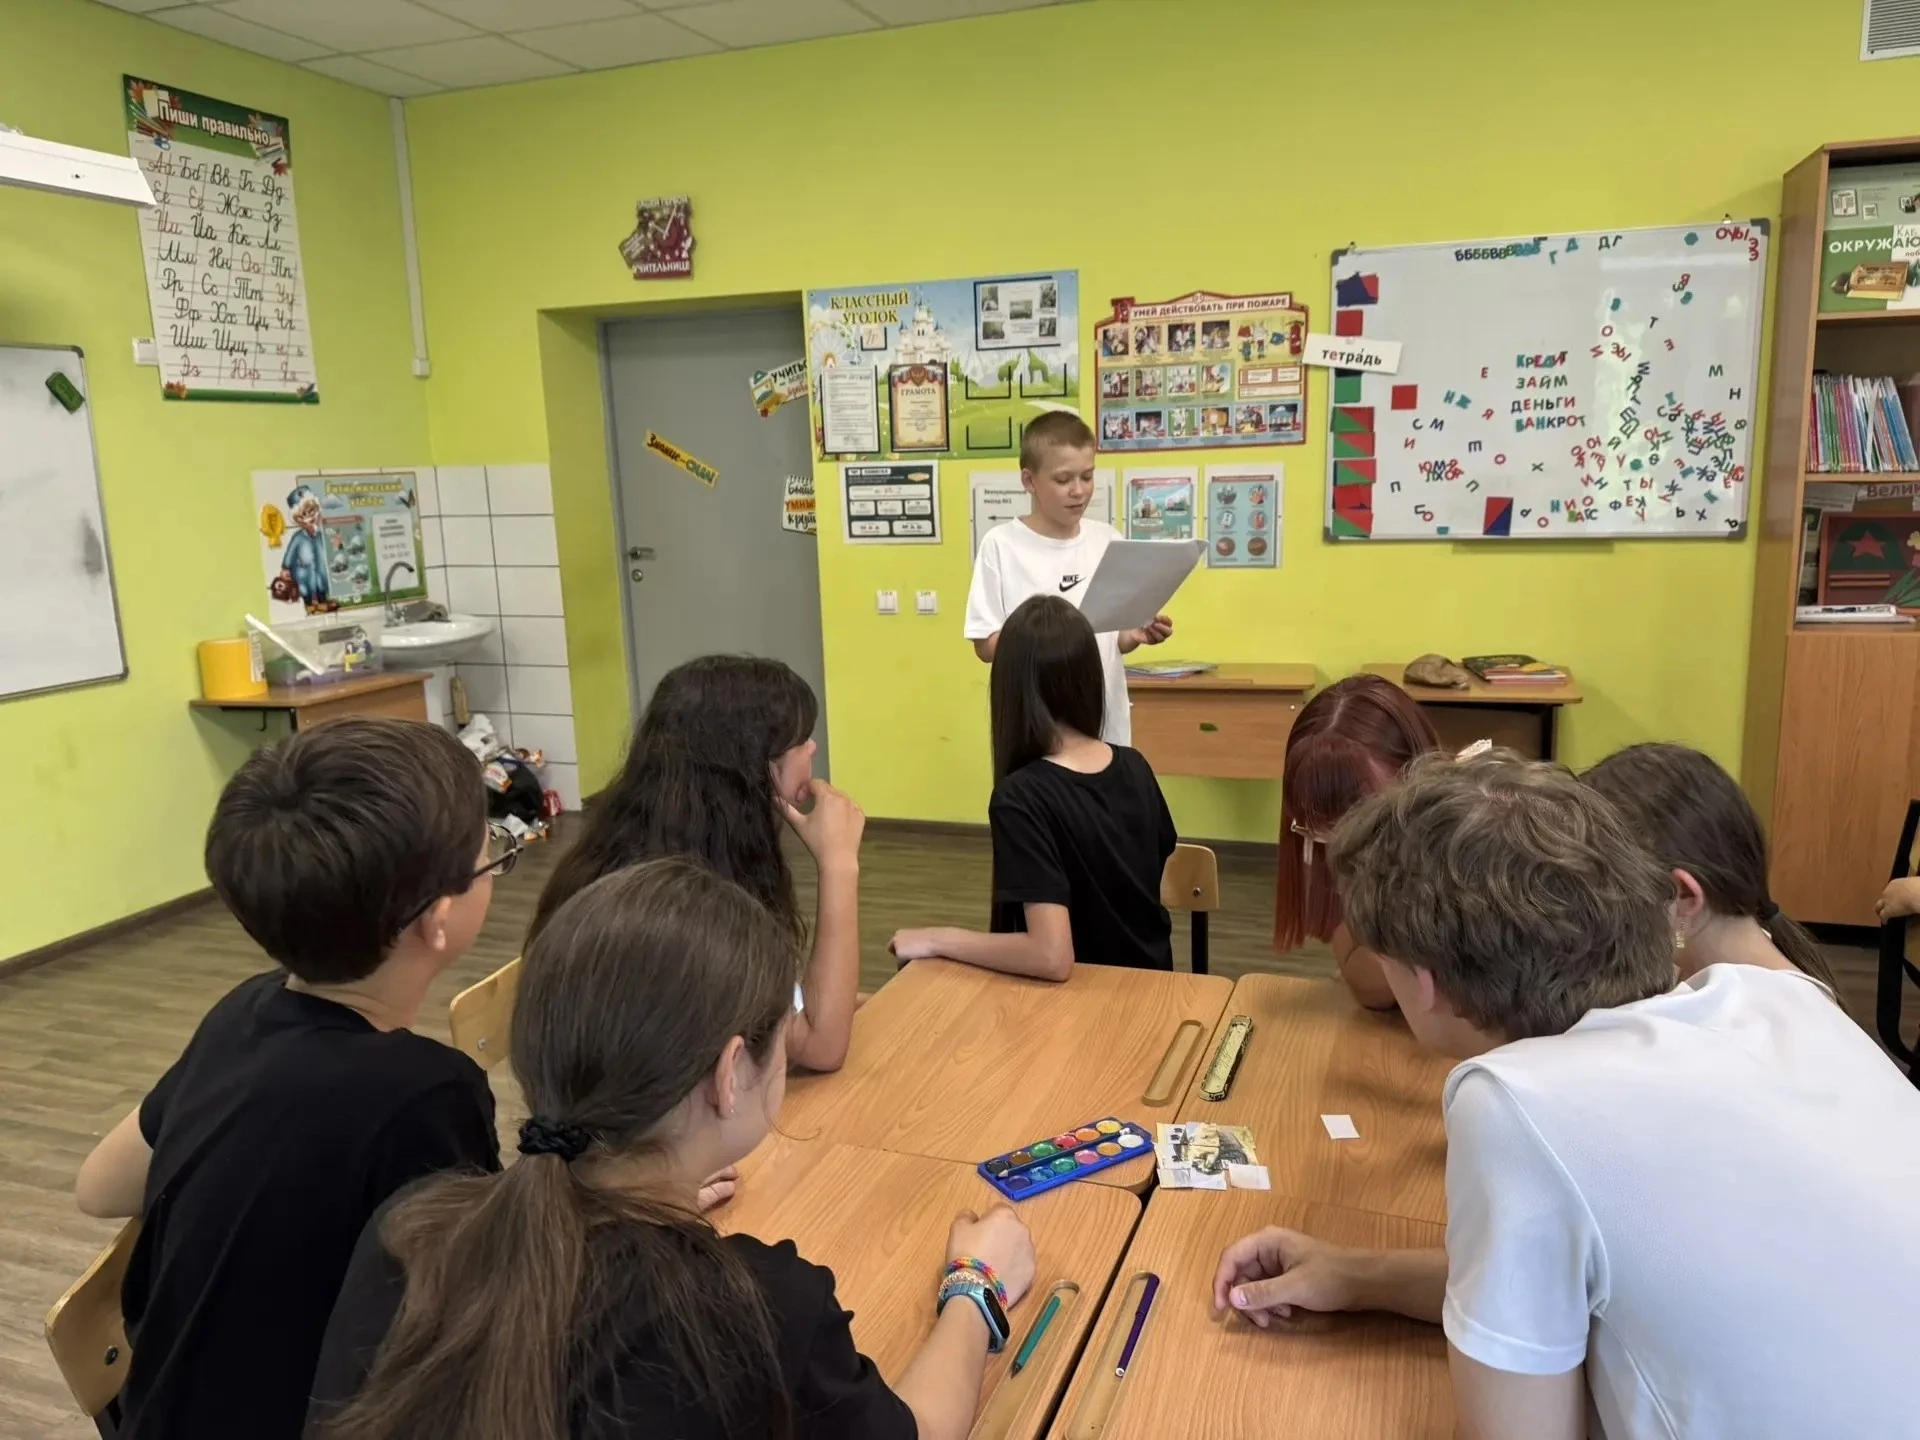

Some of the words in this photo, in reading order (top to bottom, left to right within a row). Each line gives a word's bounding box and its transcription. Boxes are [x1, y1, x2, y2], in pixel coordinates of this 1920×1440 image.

[157, 100, 198, 128] Пиши
[202, 117, 269, 144] правильно
[831, 290, 908, 309] КЛАССНЫЙ
[1133, 308, 1157, 318] УМЕЙ
[1160, 303, 1223, 317] ДЕЙСТВОВАТЬ
[1226, 301, 1245, 310] ПРИ
[1247, 297, 1288, 308] ПОЖАРЕ
[843, 310, 897, 324] УГОЛОК
[1516, 351, 1568, 368] КРЕДИТ
[1516, 374, 1568, 389] ЗАЙМ
[901, 388, 936, 396] ГРАМОТА
[1511, 396, 1575, 414] ДЕНЬГИ
[1515, 414, 1586, 432] БАНКРОТ
[1062, 574, 1079, 583] NIKE
